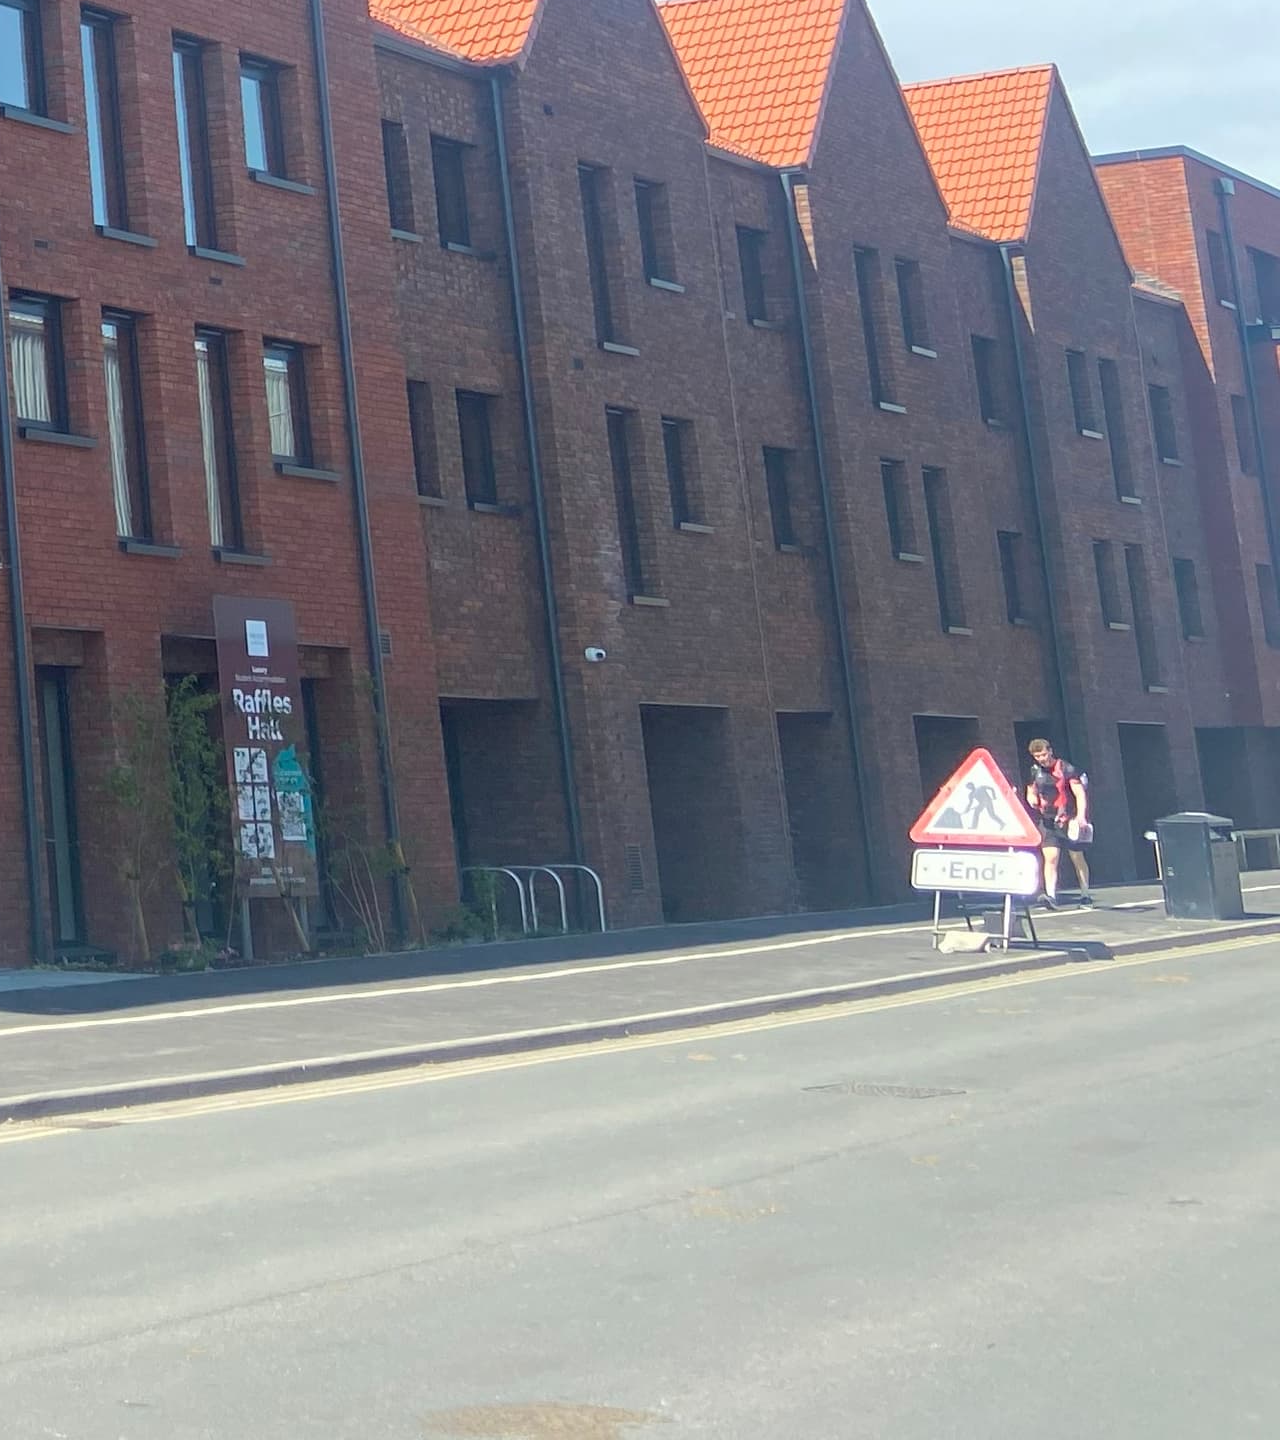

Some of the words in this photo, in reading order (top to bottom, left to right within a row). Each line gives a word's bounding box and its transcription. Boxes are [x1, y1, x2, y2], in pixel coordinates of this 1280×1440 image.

[232, 688, 292, 714] Raffles
[248, 716, 283, 741] Hall
[949, 861, 996, 881] End
